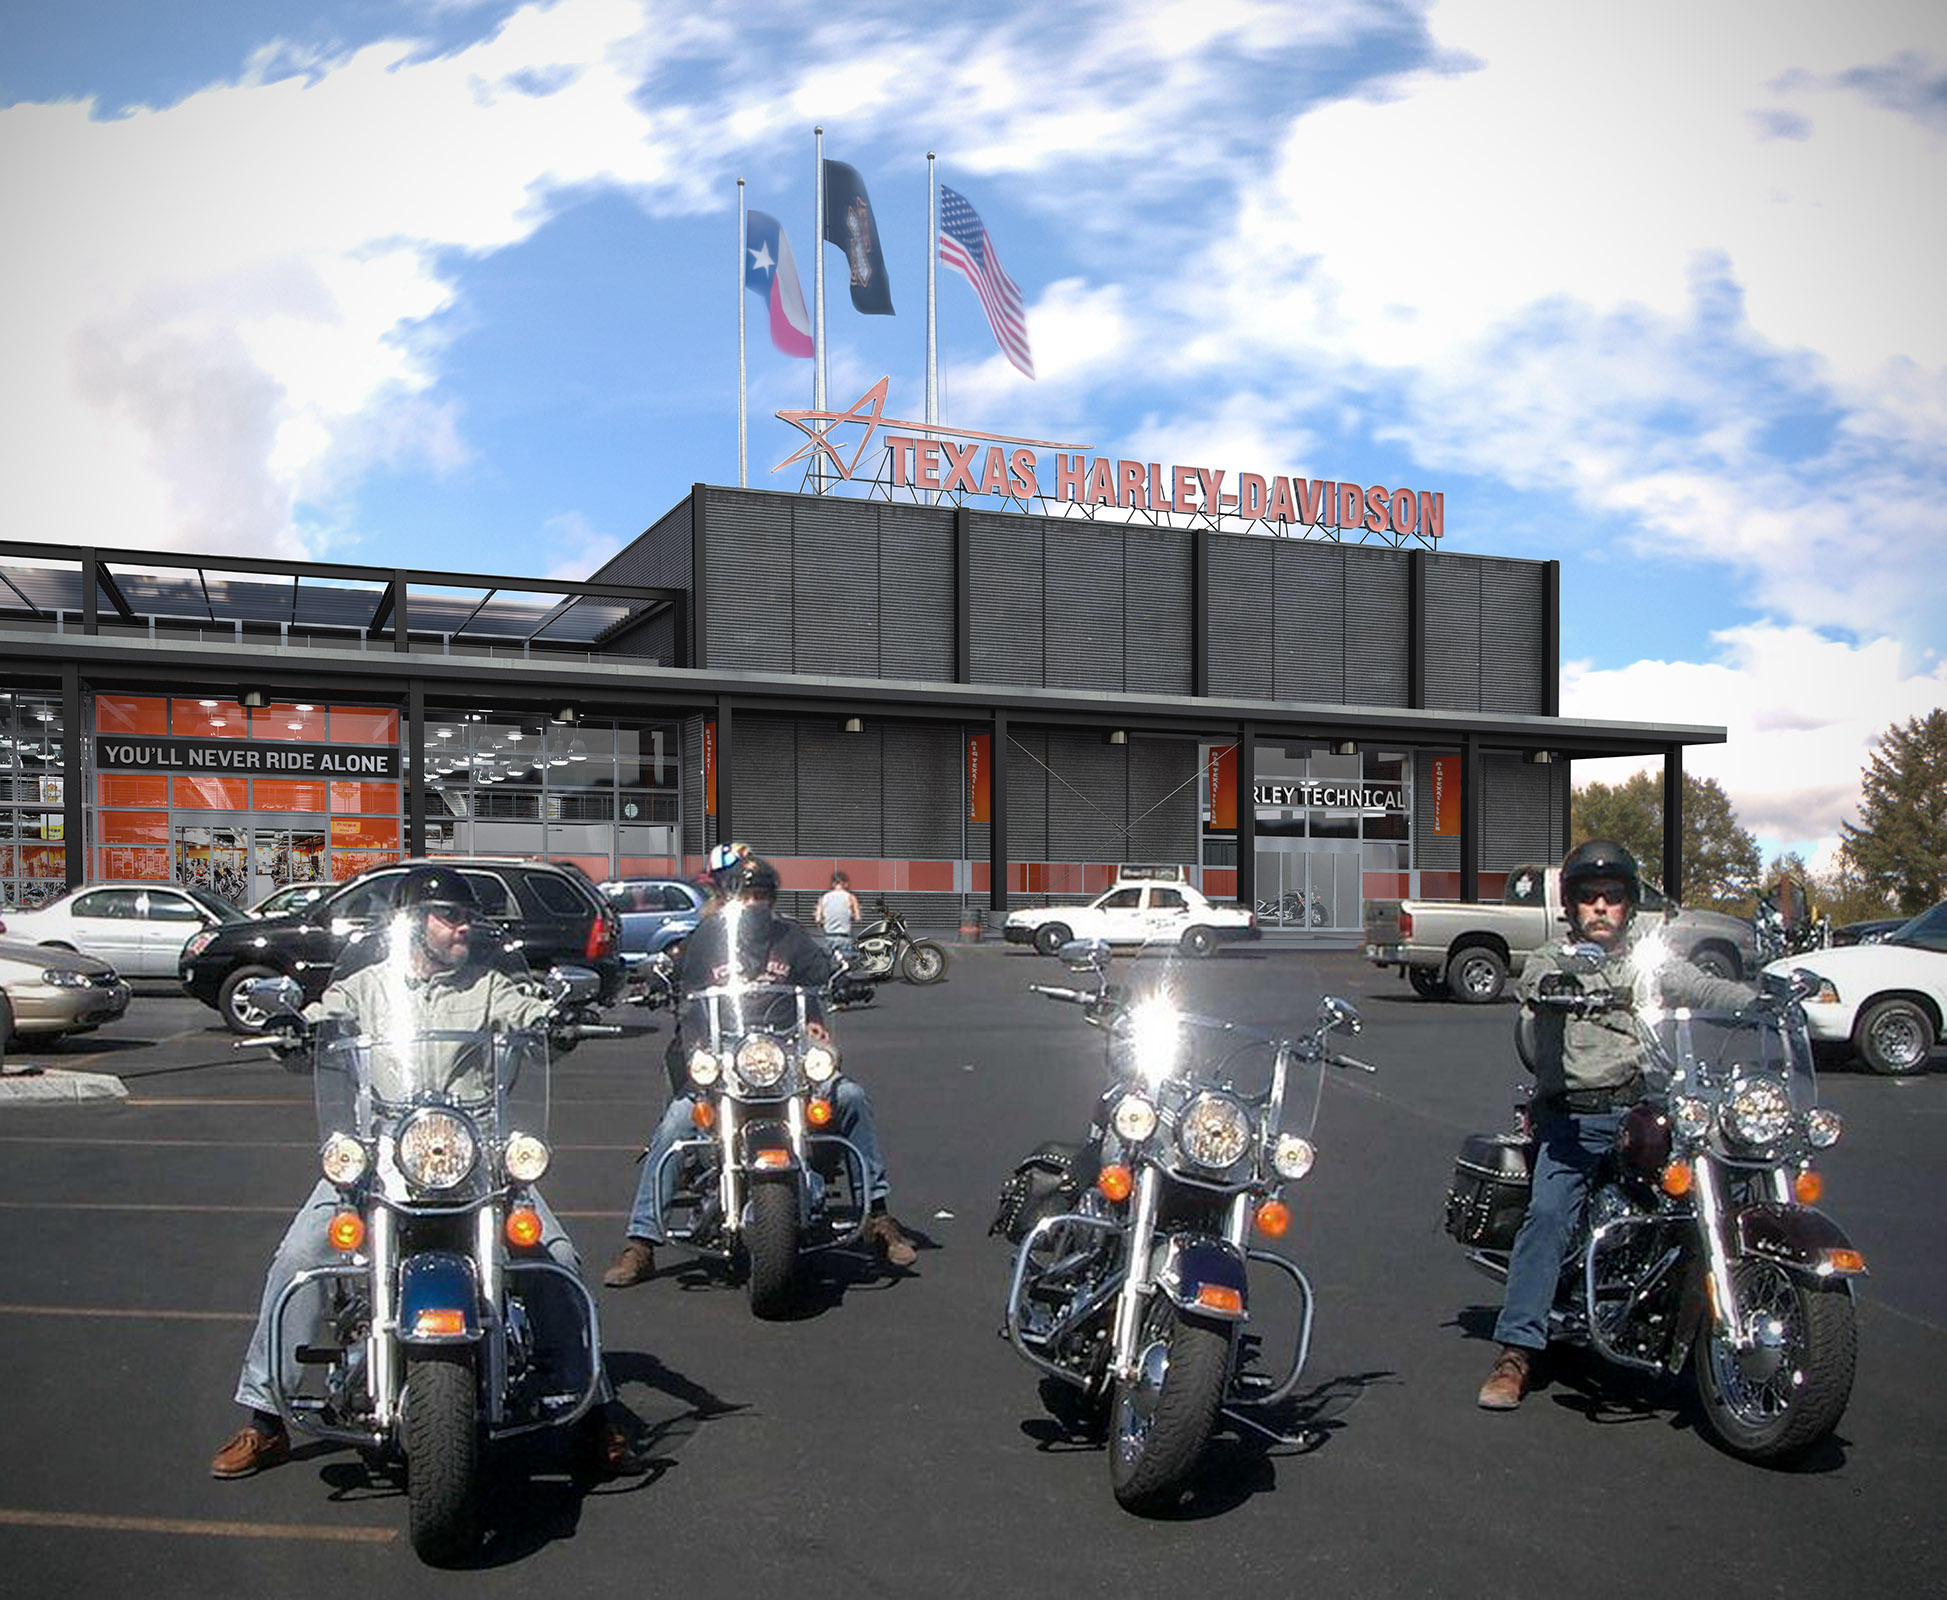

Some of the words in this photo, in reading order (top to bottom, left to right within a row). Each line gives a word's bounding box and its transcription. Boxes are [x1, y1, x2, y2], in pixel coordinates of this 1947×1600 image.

[884, 435, 1037, 499] TEXAS
[1055, 453, 1444, 537] HARLEY-DAVIDSON
[105, 745, 183, 765] YOU'LL
[188, 749, 260, 768] NEVER
[266, 751, 314, 770] RIDE
[320, 754, 388, 772] ALONE
[1300, 787, 1406, 808] TECHNICAL
